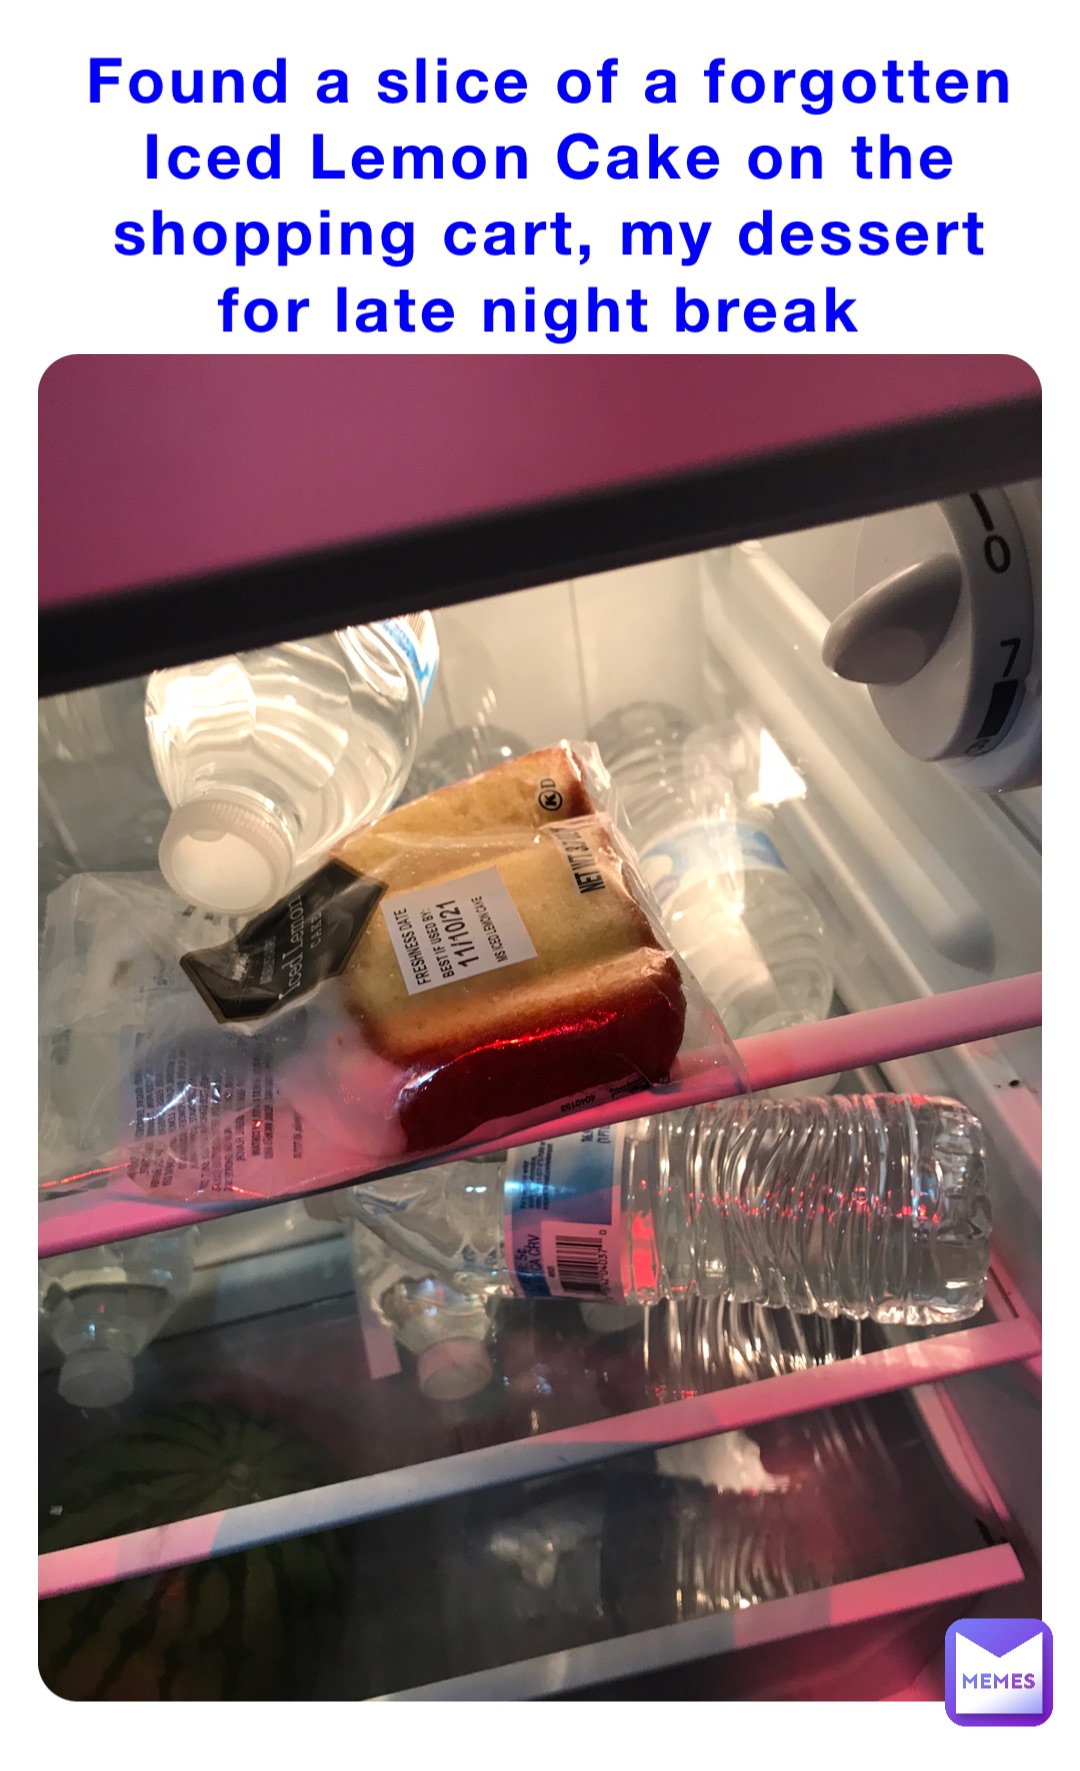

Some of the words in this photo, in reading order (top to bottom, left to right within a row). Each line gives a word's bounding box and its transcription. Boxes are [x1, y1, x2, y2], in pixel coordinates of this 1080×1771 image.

[984, 534, 1011, 574] 0
[1000, 638, 1021, 678] 7
[574, 871, 606, 894] NET
[282, 894, 305, 960] Lemon
[310, 910, 323, 949] CAKE
[393, 907, 413, 932] DATE
[425, 923, 442, 945] USED
[436, 900, 479, 968] 11/10/21
[479, 913, 497, 936] LEMON
[402, 929, 431, 986] FRESHNESS
[432, 945, 446, 956] IF
[488, 934, 504, 952] ICED
[278, 952, 304, 1000] Iced
[437, 954, 455, 979] BEST
